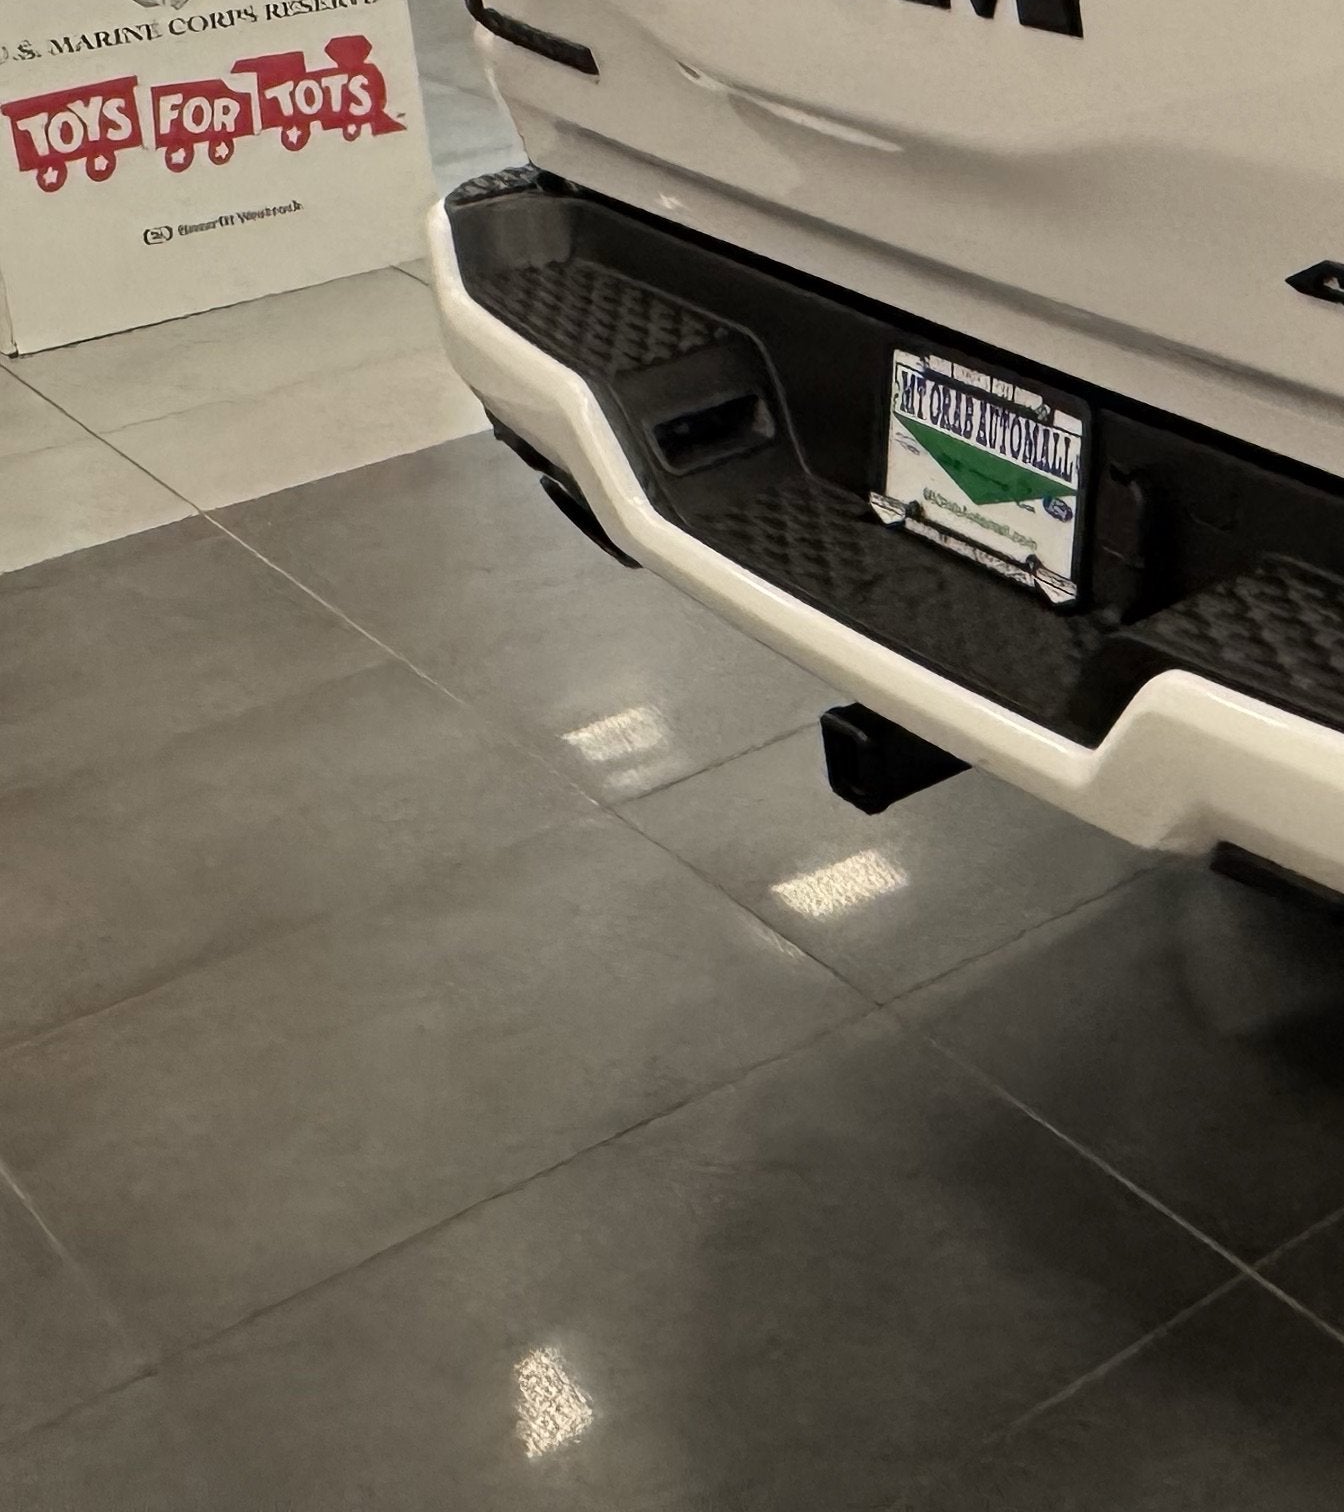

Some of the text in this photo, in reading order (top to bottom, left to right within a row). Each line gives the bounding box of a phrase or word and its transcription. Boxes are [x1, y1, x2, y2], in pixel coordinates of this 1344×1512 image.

[50, 22, 161, 56] MARINE
[168, 5, 258, 36] CORPS
[17, 73, 373, 156] TOYS FOR TOTS
[975, 400, 1073, 483] AUTOMALL
